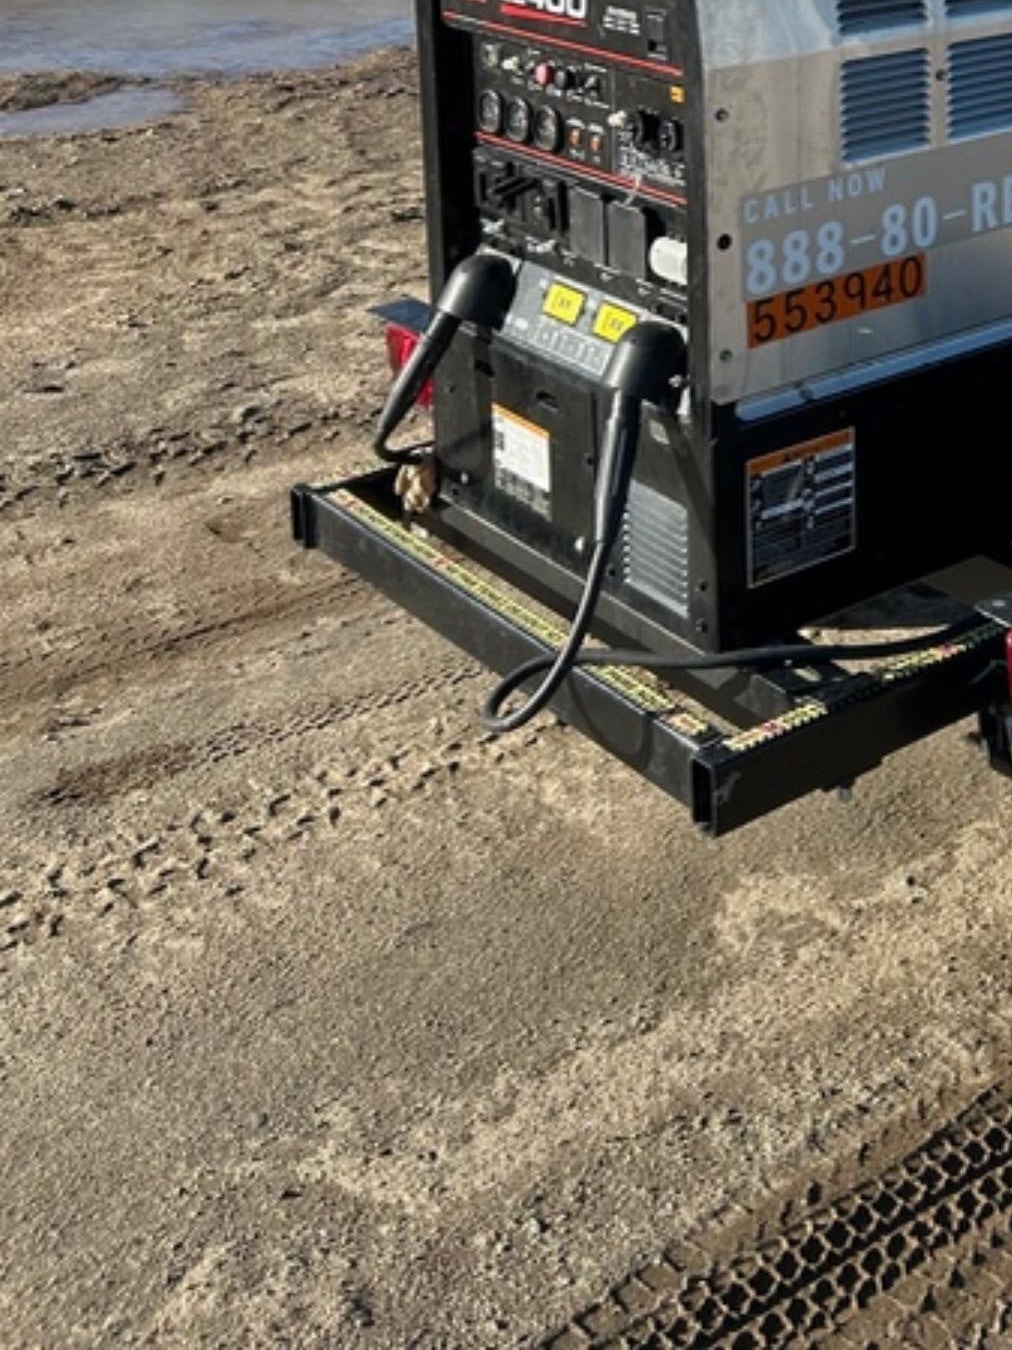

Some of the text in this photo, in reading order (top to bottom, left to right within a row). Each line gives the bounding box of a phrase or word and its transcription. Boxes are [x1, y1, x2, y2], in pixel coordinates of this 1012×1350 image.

[744, 167, 887, 224] CALL NOW
[751, 255, 924, 344] 553940
